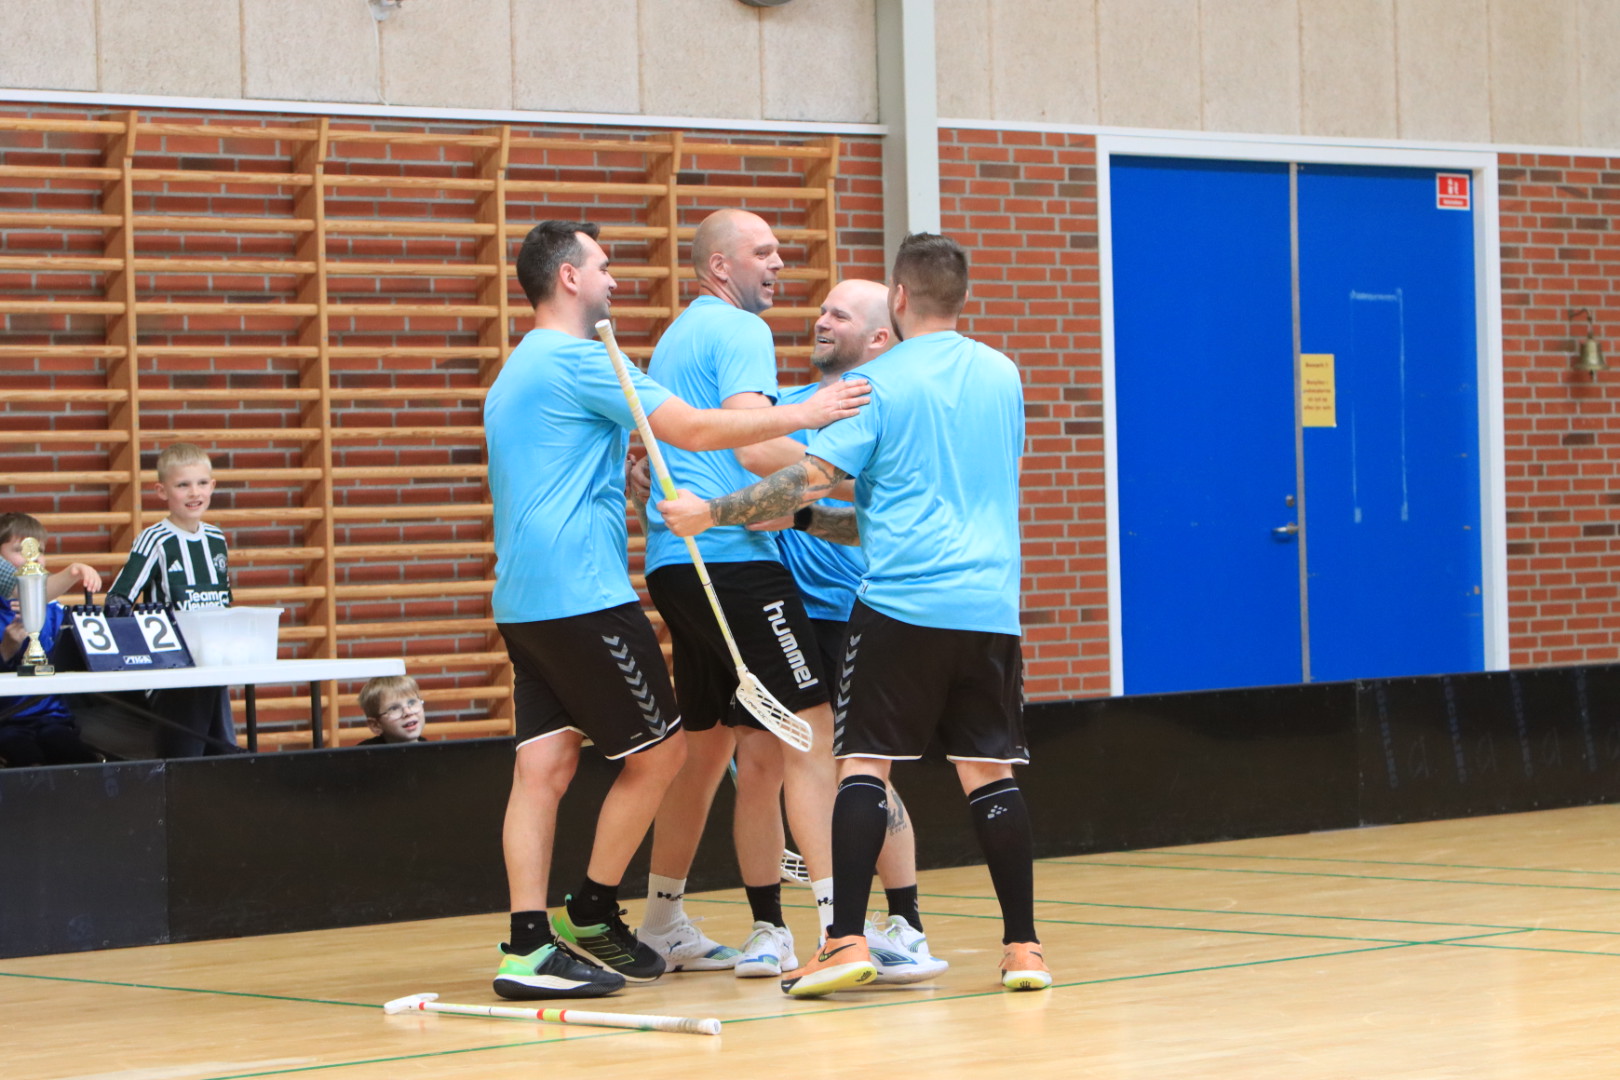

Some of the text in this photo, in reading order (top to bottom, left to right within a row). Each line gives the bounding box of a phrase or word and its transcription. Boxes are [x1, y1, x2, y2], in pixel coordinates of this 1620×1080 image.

[185, 589, 219, 602] Team
[82, 616, 176, 651] 3 2
[763, 600, 818, 689] hummel
